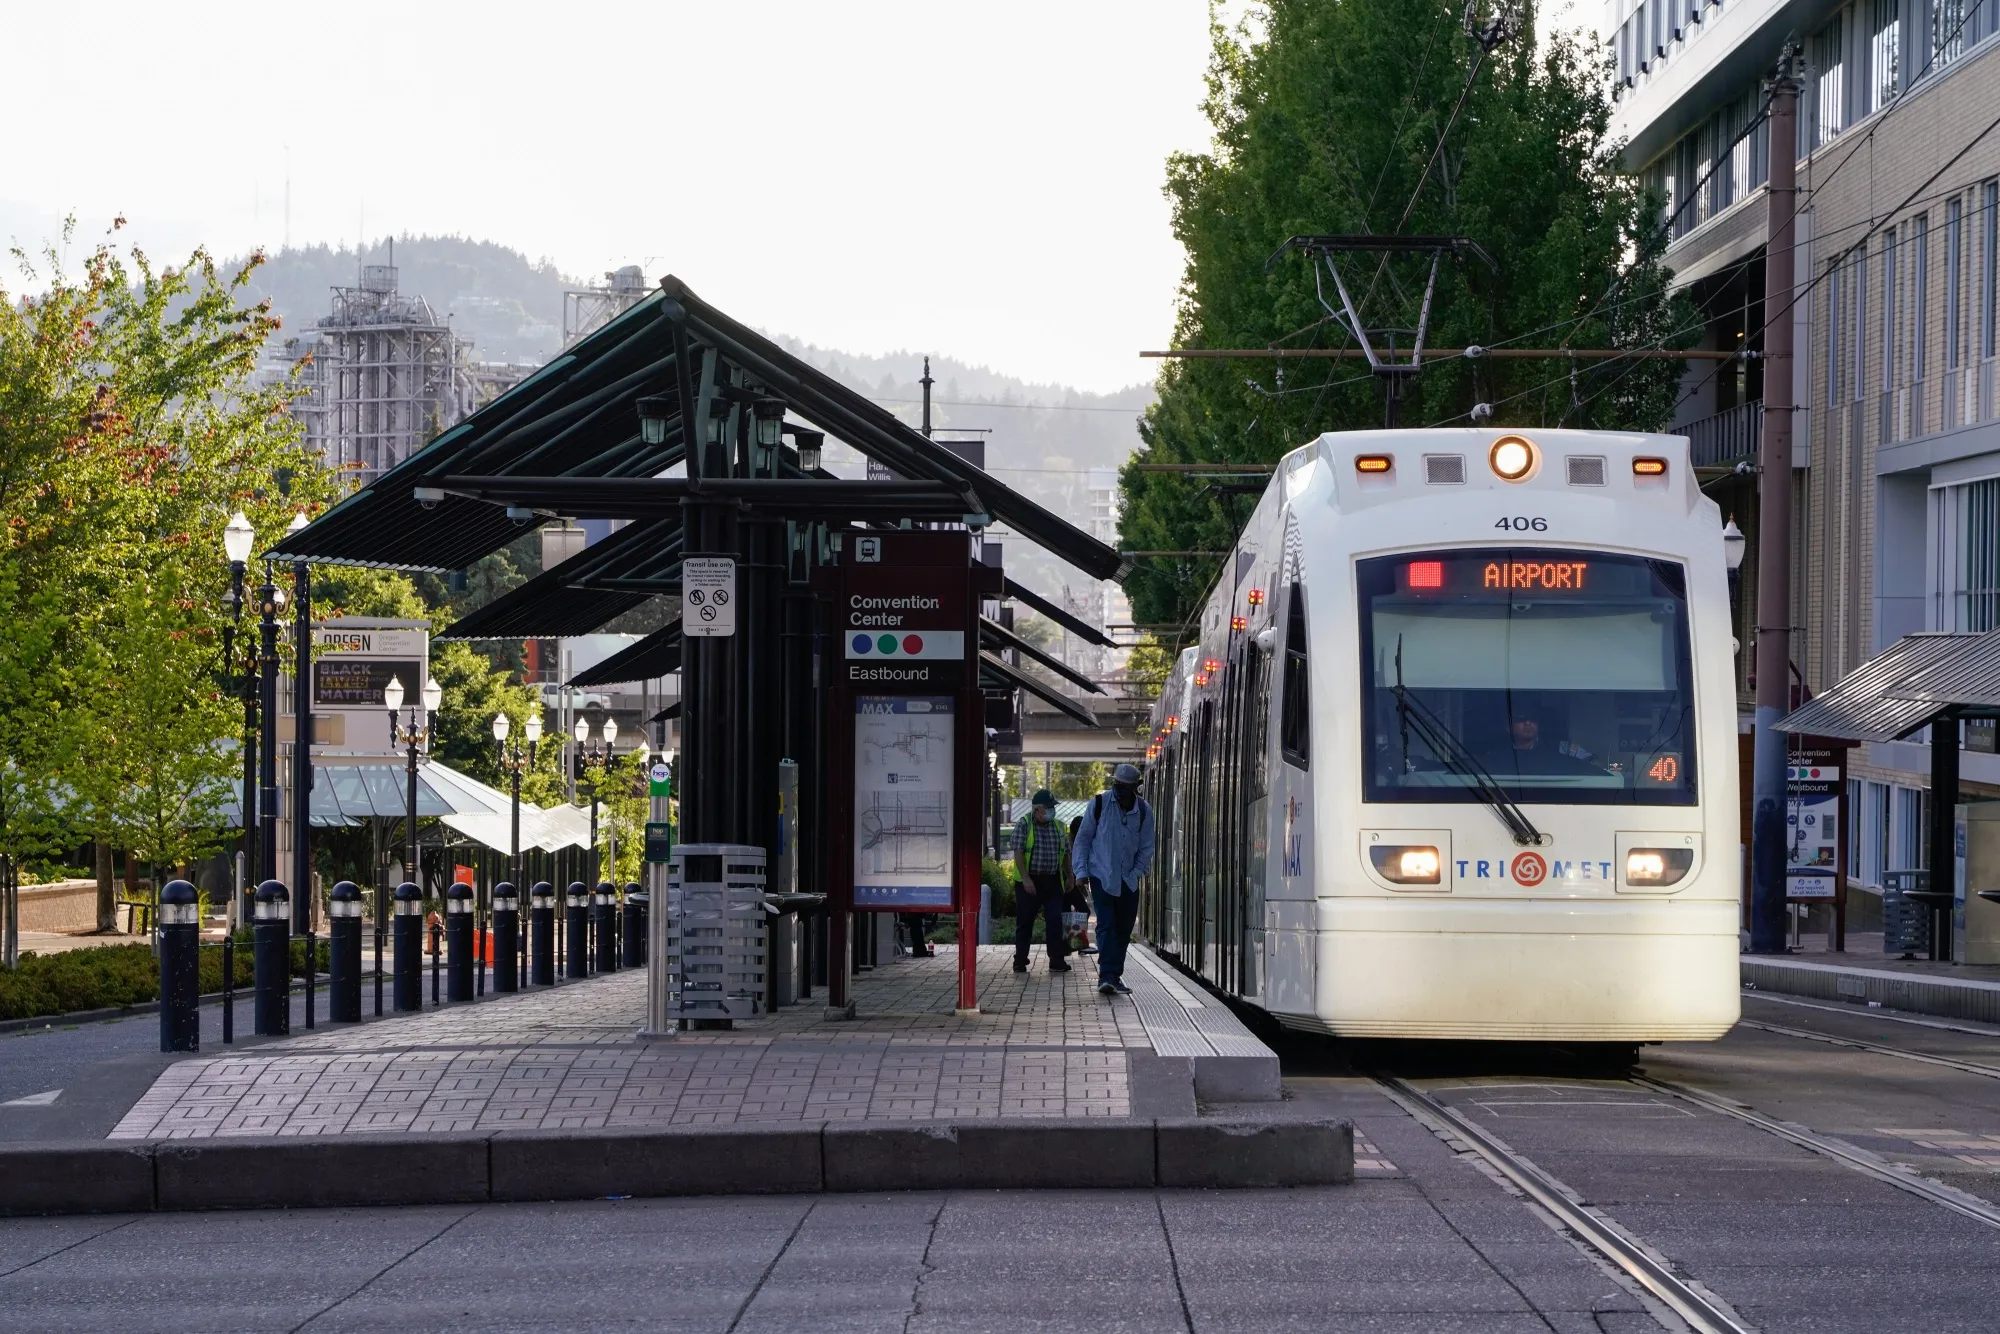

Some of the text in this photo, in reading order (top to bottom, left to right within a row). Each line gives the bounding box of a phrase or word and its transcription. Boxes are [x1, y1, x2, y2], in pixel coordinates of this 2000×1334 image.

[1494, 516, 1548, 532] 406
[1484, 563, 1587, 588] AIRPORT
[850, 594, 940, 609] Convention
[850, 611, 904, 626] Center
[320, 664, 372, 675] BLACK
[849, 666, 929, 680] Eastbound
[320, 689, 383, 700] MATTER
[861, 703, 895, 715] MAX
[1649, 757, 1676, 781] 40
[1456, 860, 1505, 878] TRI
